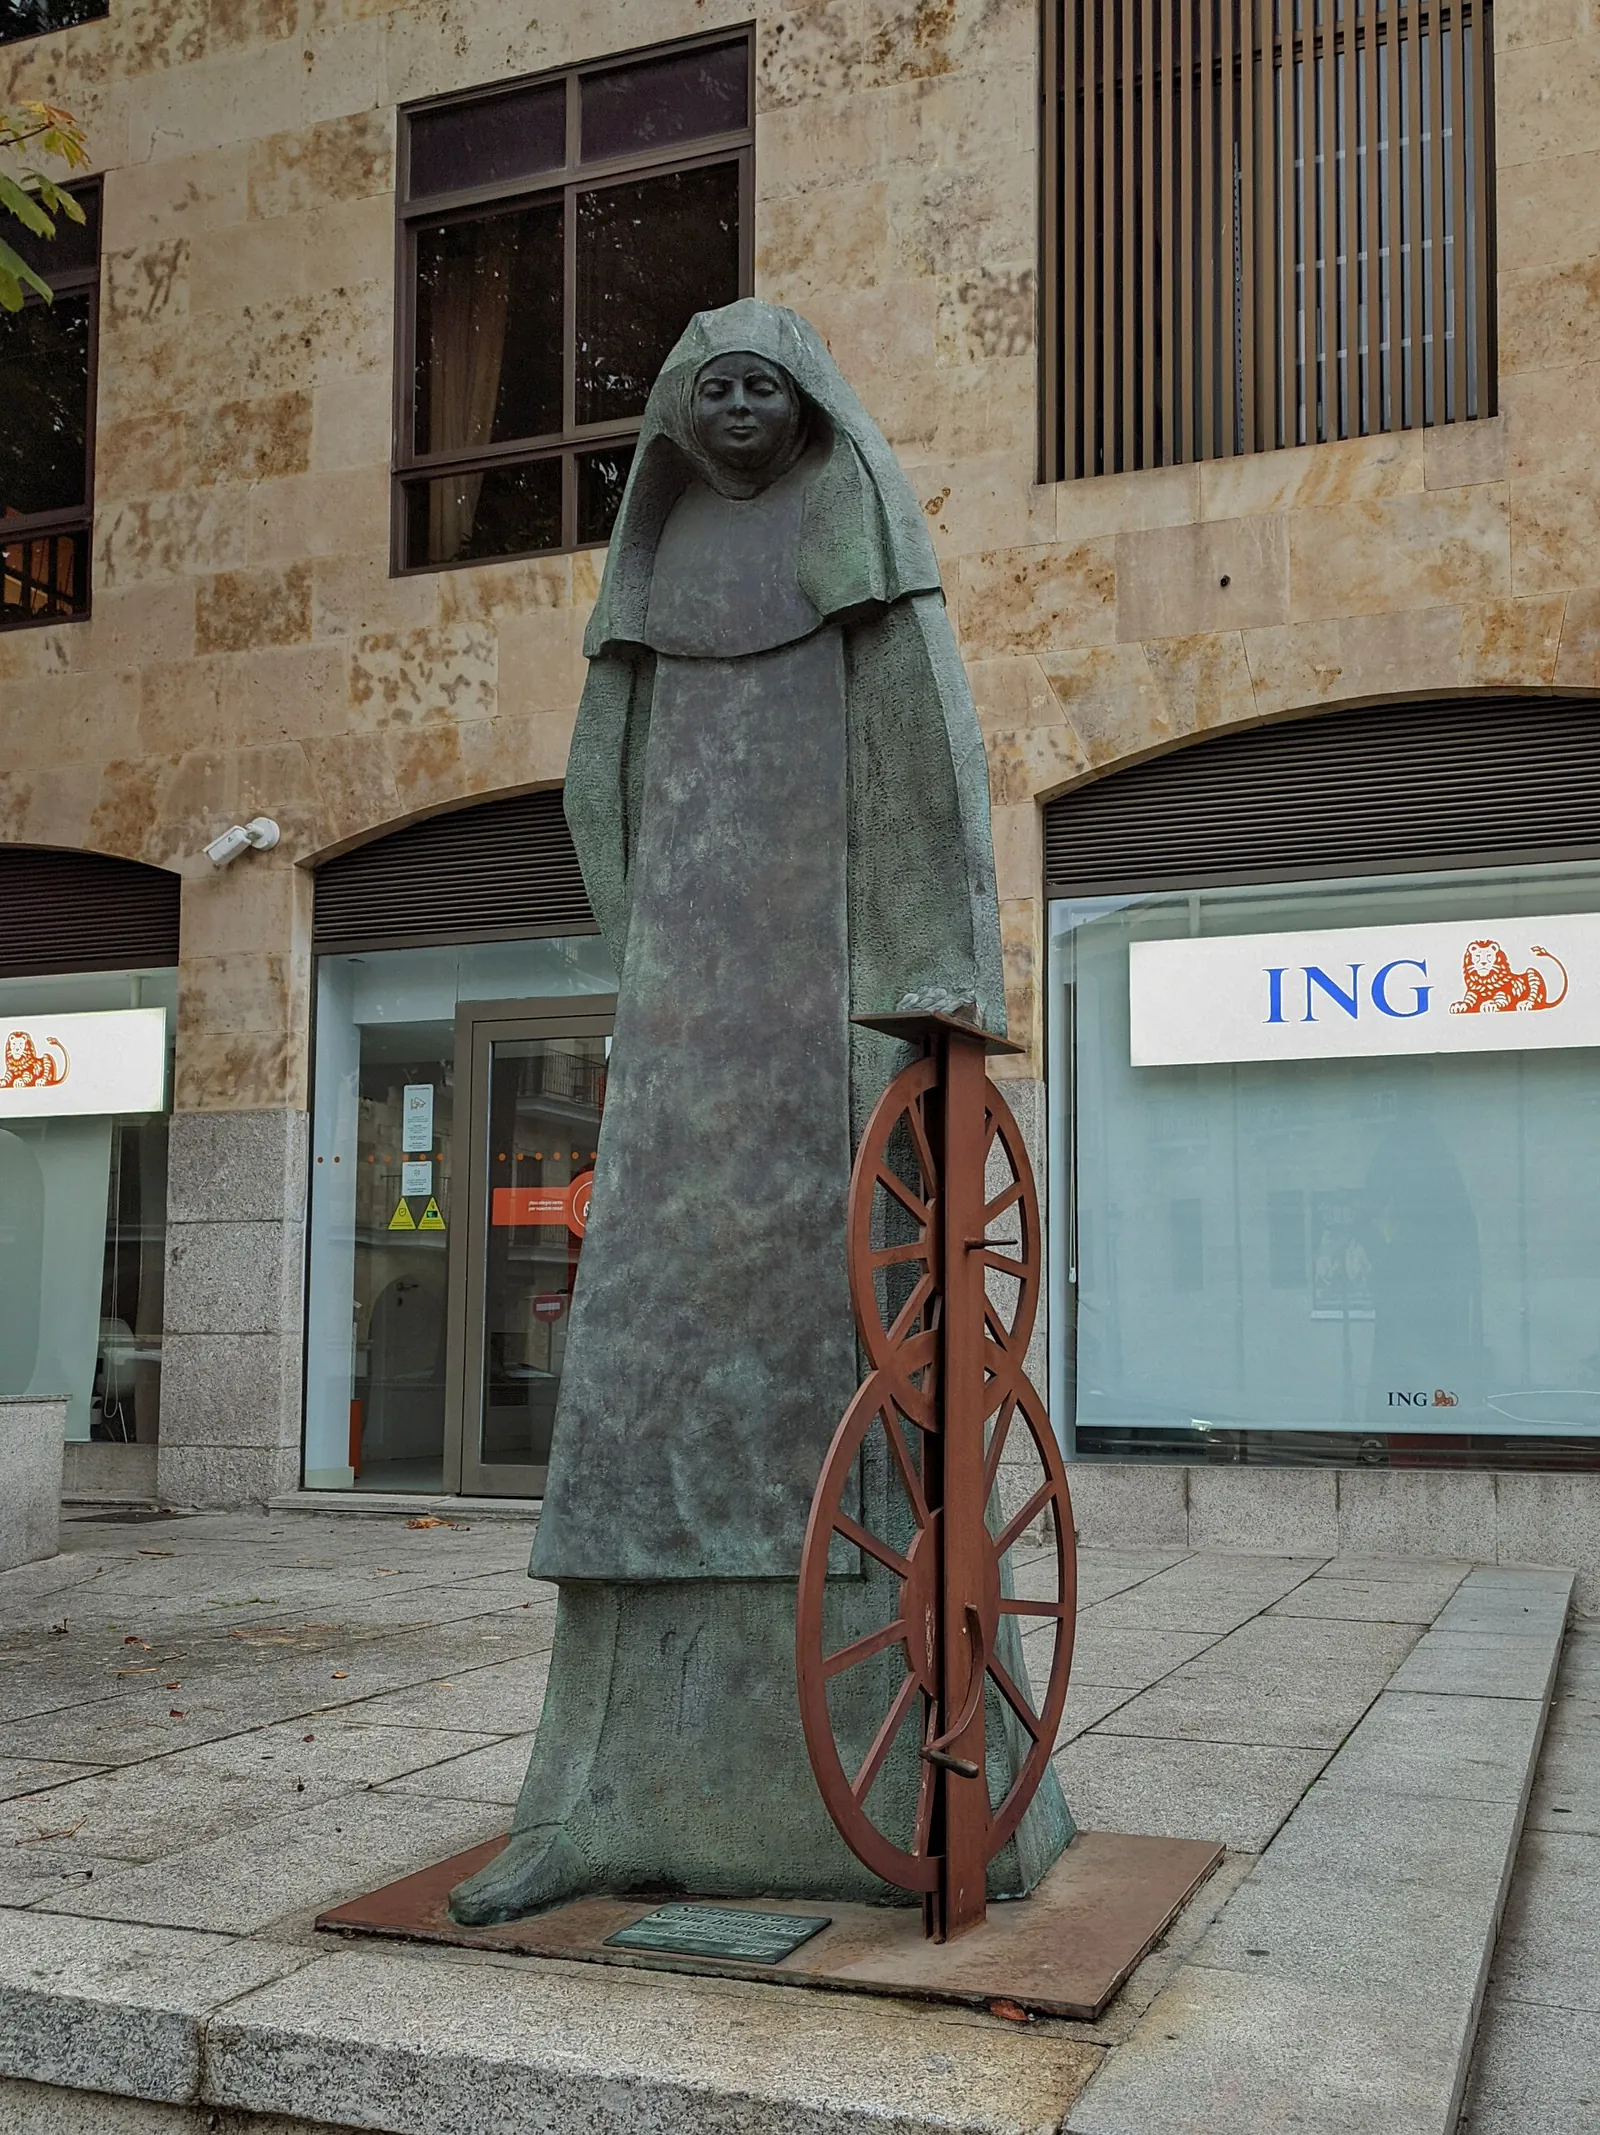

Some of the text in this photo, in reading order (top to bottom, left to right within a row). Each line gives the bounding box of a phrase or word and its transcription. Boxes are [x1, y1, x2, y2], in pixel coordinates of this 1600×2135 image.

[1262, 958, 1434, 1024] ING
[1387, 1391, 1428, 1407] ING
[650, 1912, 811, 1935] Santa Bonifacia
[676, 1906, 785, 1923] Salamanca
